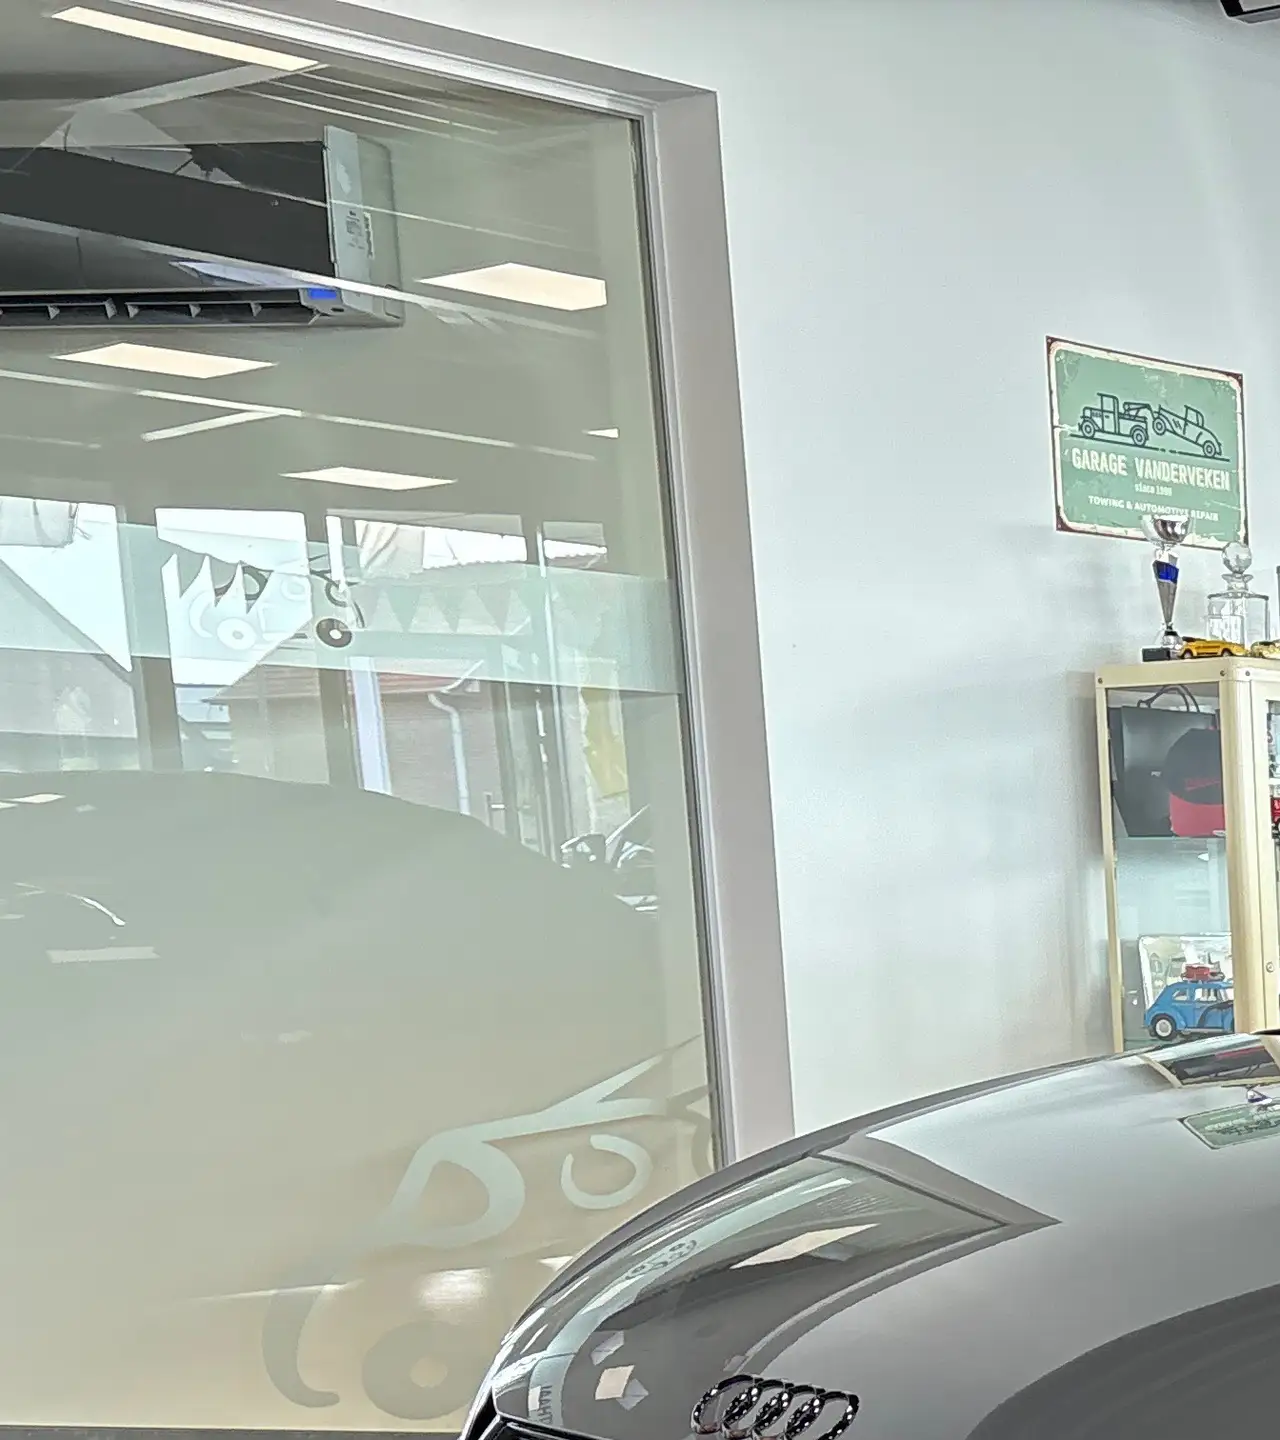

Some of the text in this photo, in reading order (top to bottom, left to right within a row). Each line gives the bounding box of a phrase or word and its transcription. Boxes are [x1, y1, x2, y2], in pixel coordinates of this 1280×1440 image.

[1072, 447, 1231, 492] GARAGE VANDERVEKEN
[1088, 495, 1125, 509] TOWING
[1134, 501, 1189, 518] AUTOMOTIVE
[1190, 509, 1220, 522] REPAIR
